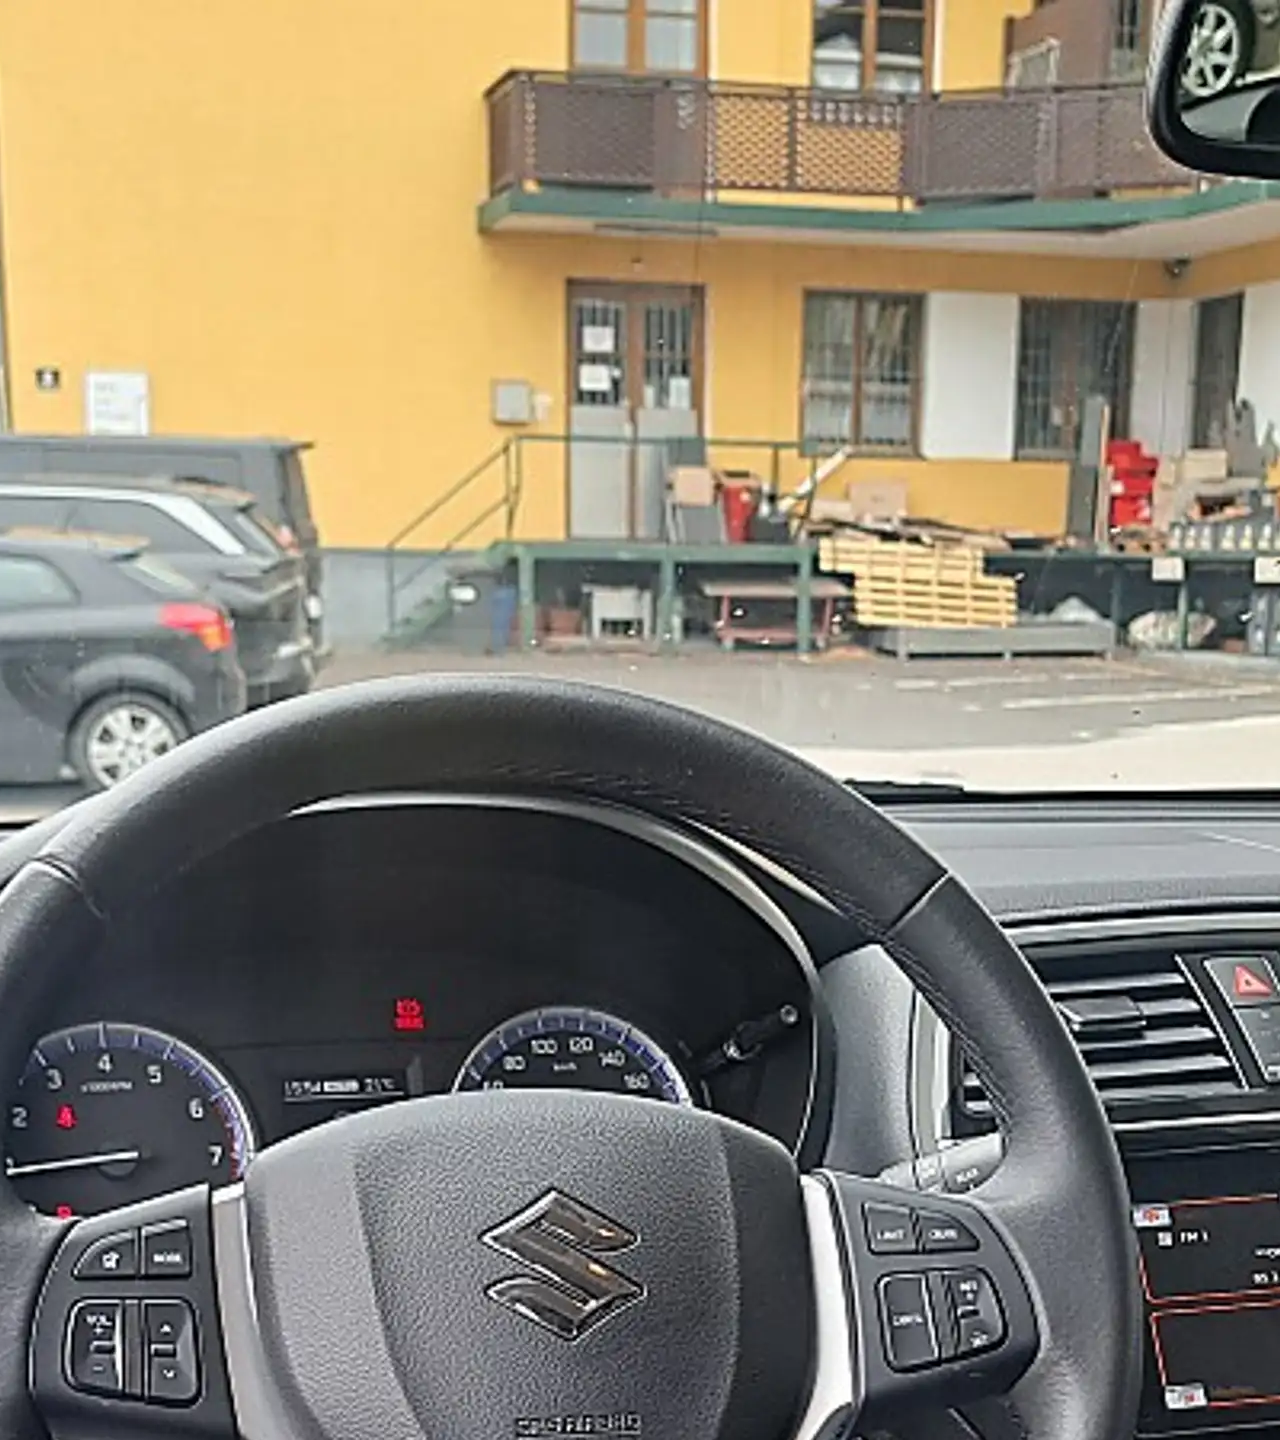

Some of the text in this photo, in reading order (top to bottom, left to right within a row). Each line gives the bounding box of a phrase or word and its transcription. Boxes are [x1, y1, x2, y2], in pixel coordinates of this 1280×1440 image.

[531, 1036, 594, 1055] 100 120
[97, 1052, 113, 1074] 4
[46, 1068, 64, 1090] 3
[146, 1064, 162, 1085] 5
[11, 1106, 28, 1129] 2
[189, 1098, 204, 1119] 6
[208, 1145, 223, 1166] 7
